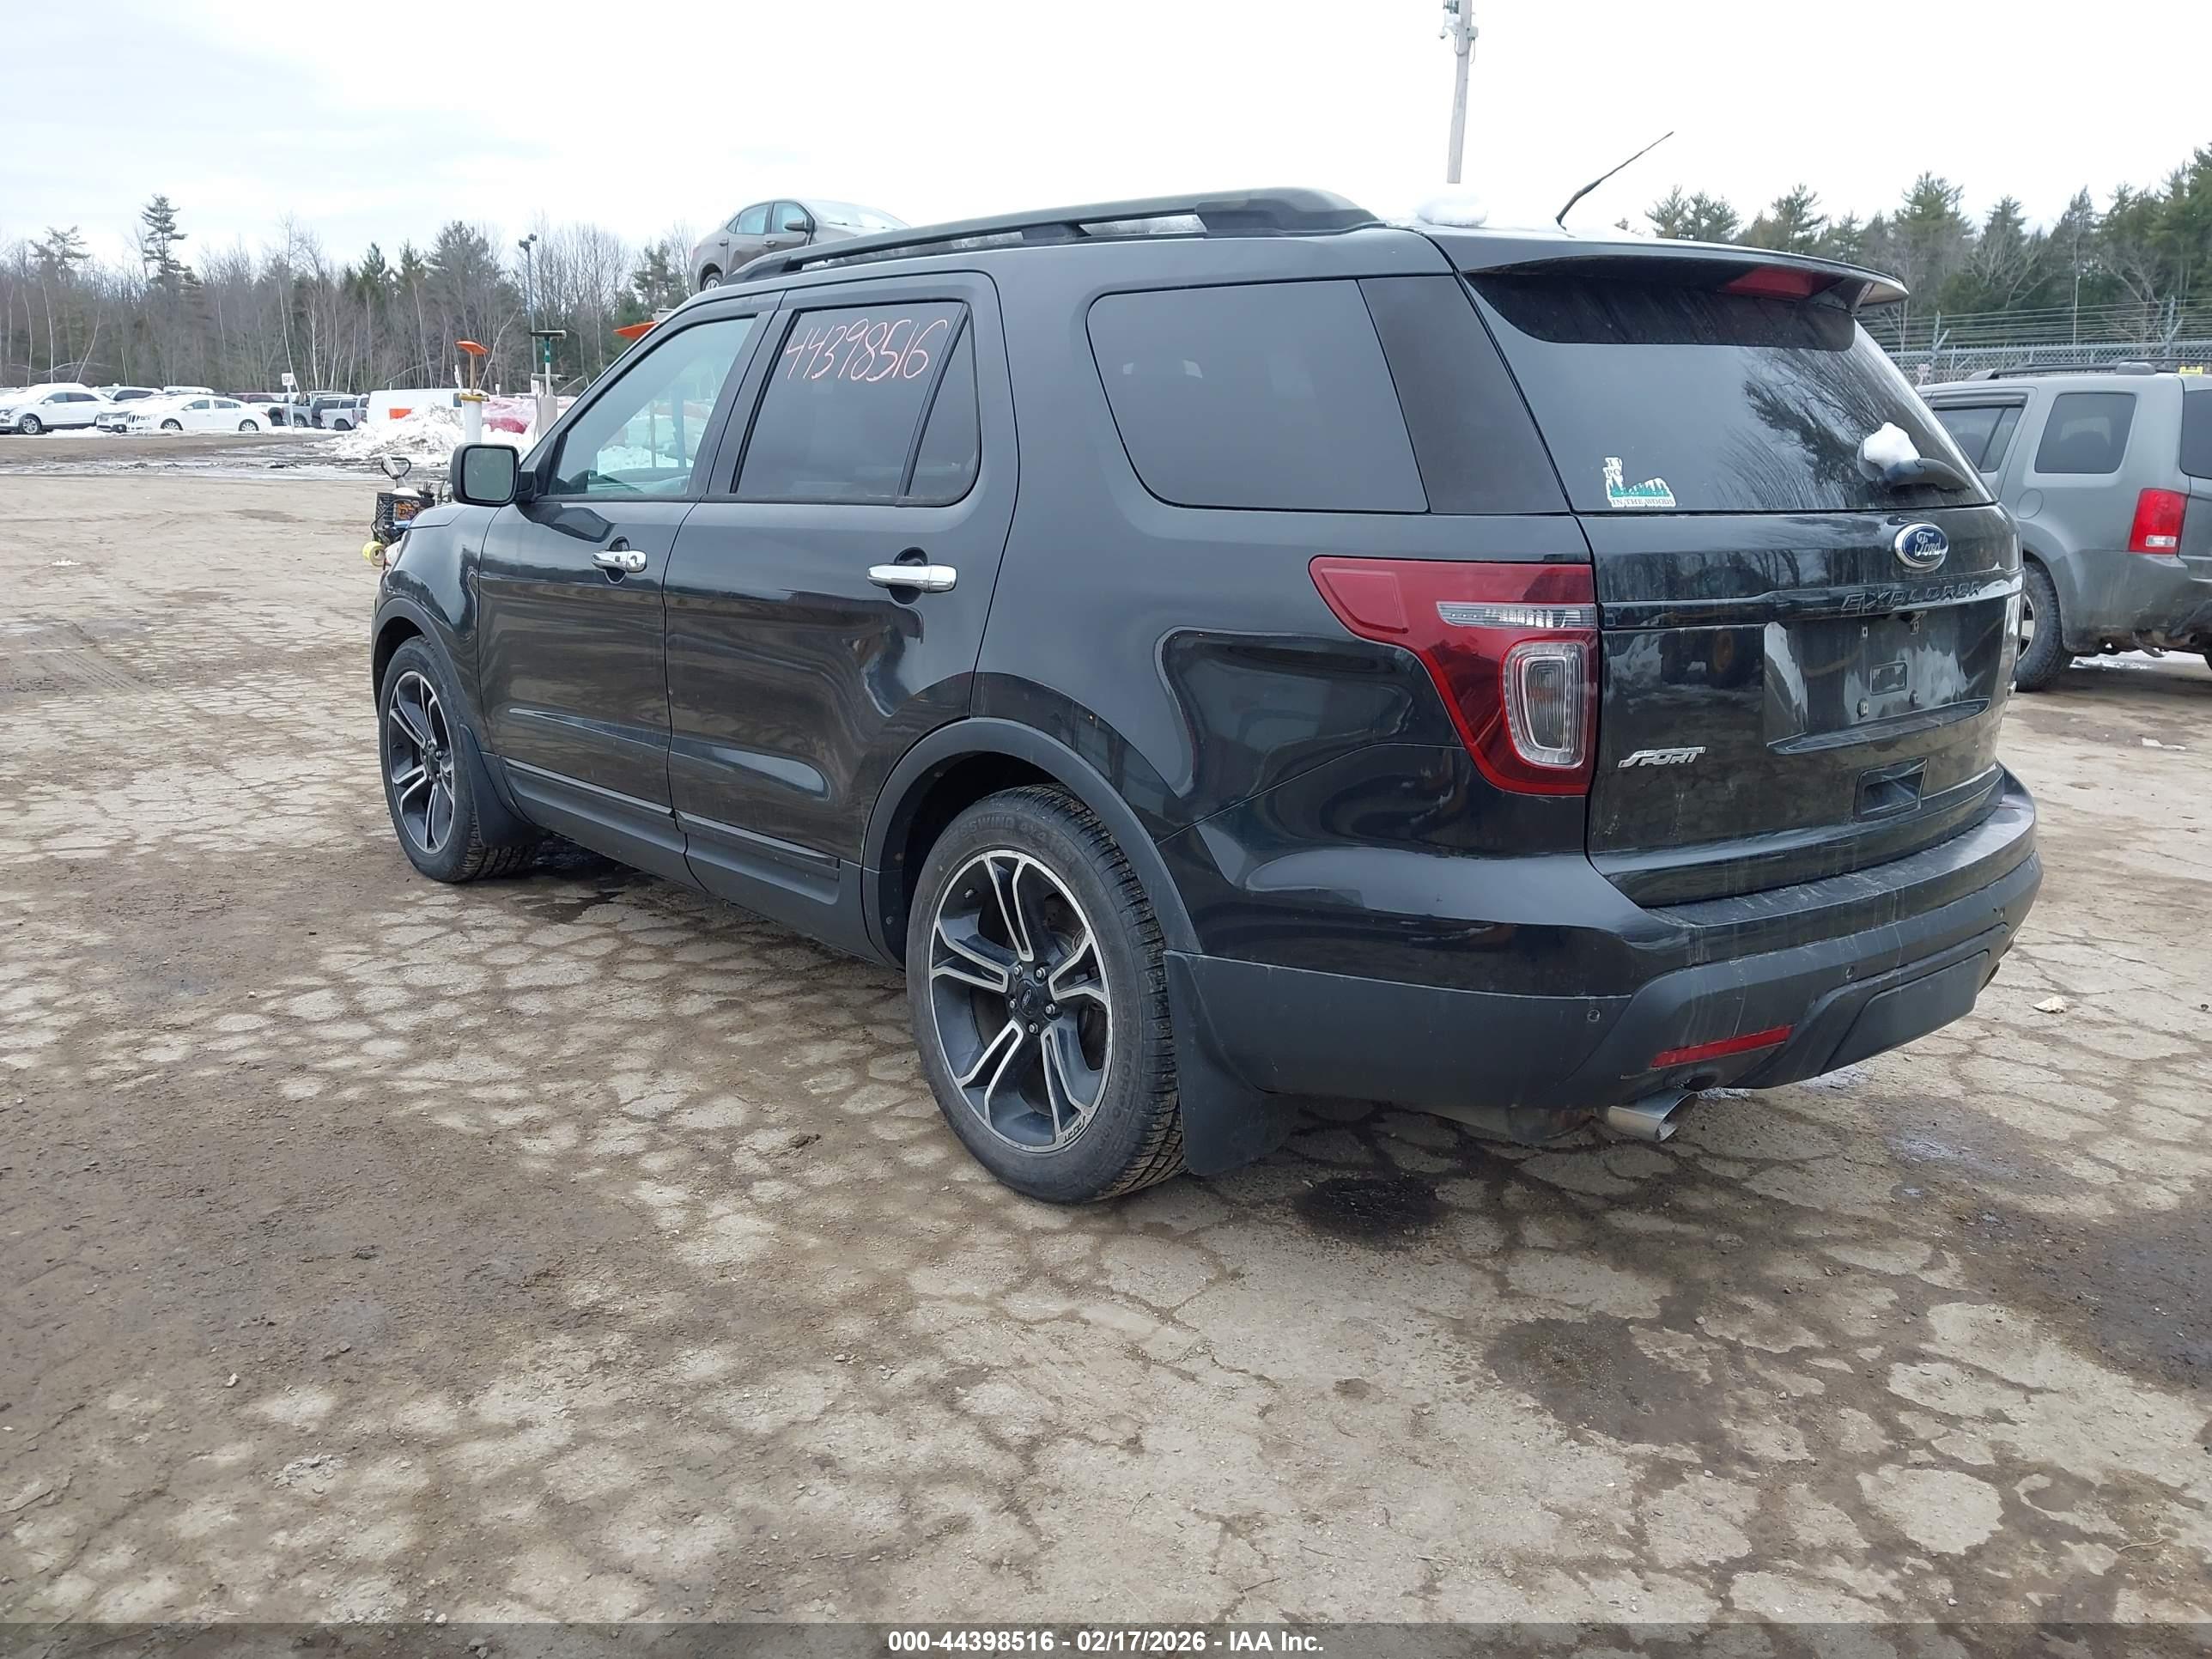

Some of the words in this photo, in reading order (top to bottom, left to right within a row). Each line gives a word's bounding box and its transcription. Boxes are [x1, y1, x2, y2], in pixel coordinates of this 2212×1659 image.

[785, 318, 949, 382] 44398516
[1914, 531, 1944, 556] Ford
[1840, 581, 1982, 612] EXPLORER
[1617, 746, 1707, 769] SPORT
[1063, 1115, 1086, 1144] SPORT
